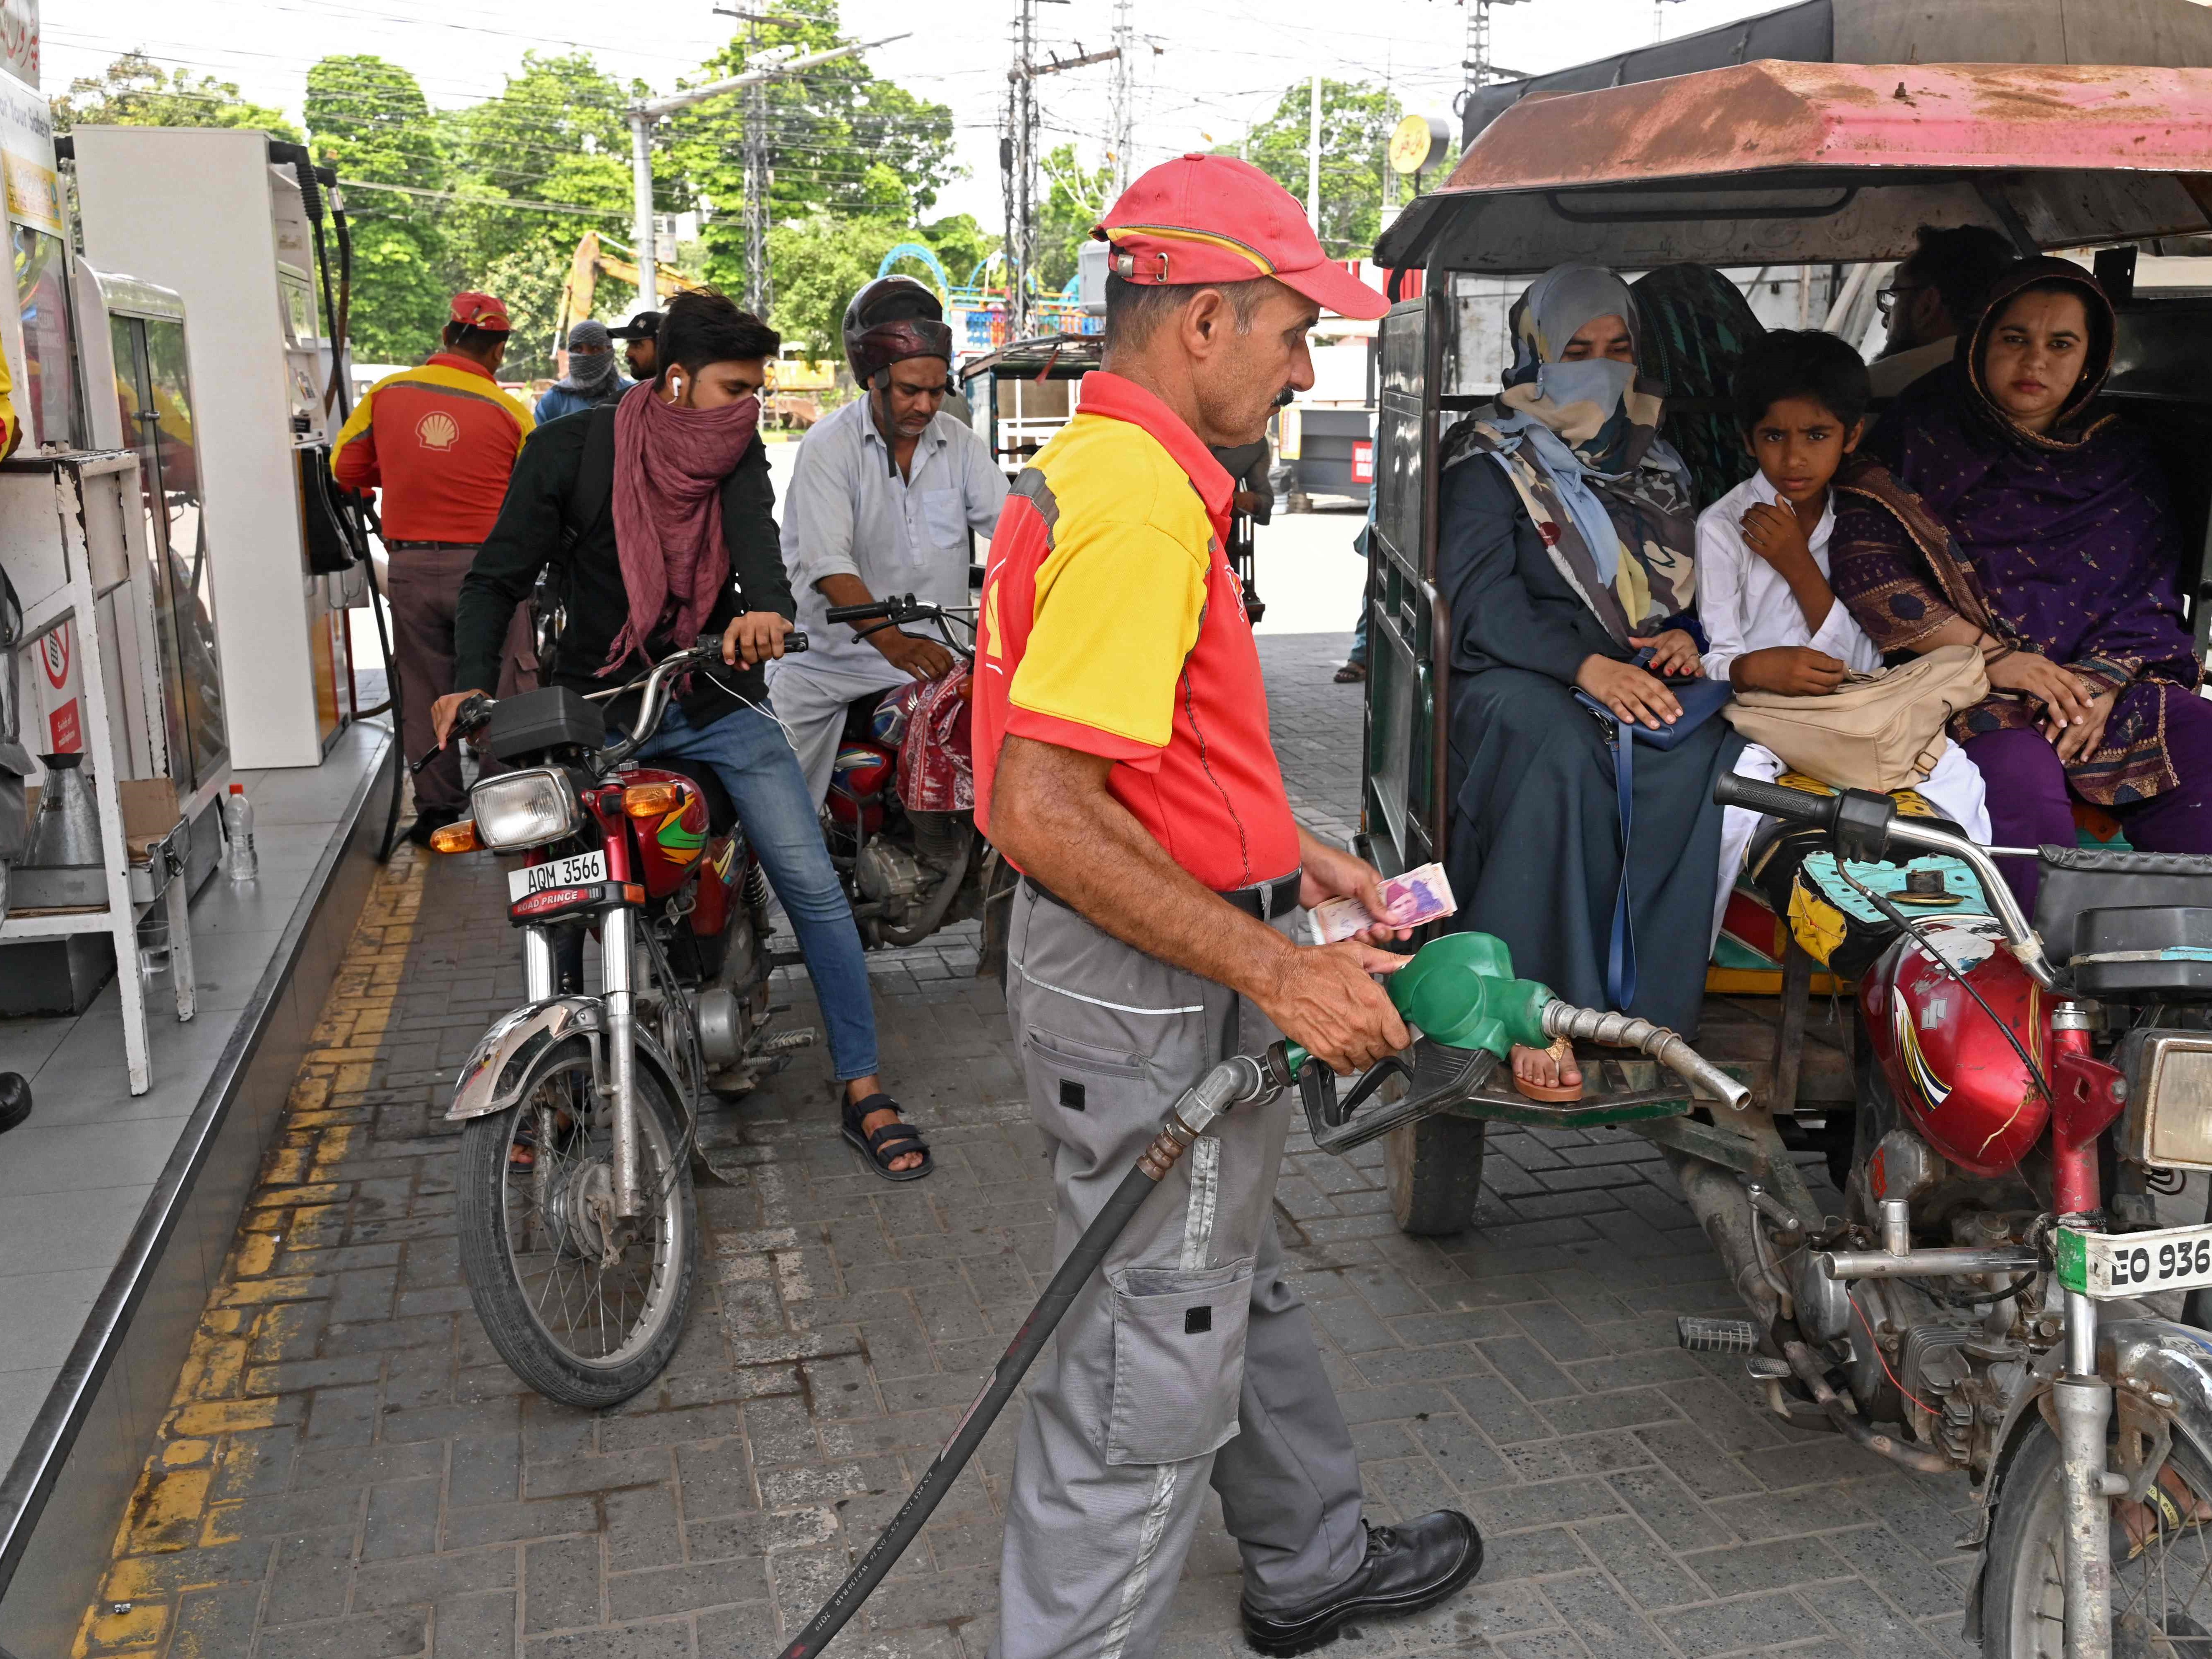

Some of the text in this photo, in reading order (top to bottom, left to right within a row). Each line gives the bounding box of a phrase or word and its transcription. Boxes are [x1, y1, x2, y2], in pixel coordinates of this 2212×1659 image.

[28, 106, 50, 147] Safety
[528, 855, 599, 893] AQM 3566
[517, 891, 578, 912] ROAD PRINCE
[923, 1471, 933, 1485] EN
[914, 1485, 924, 1499] 853
[877, 1538, 886, 1552] DN
[869, 1551, 877, 1562] 16
[858, 1565, 869, 1578] WP
[848, 1576, 858, 1590] 130
[834, 1589, 849, 1606] BAR
[815, 1611, 831, 1631] 2Q19
